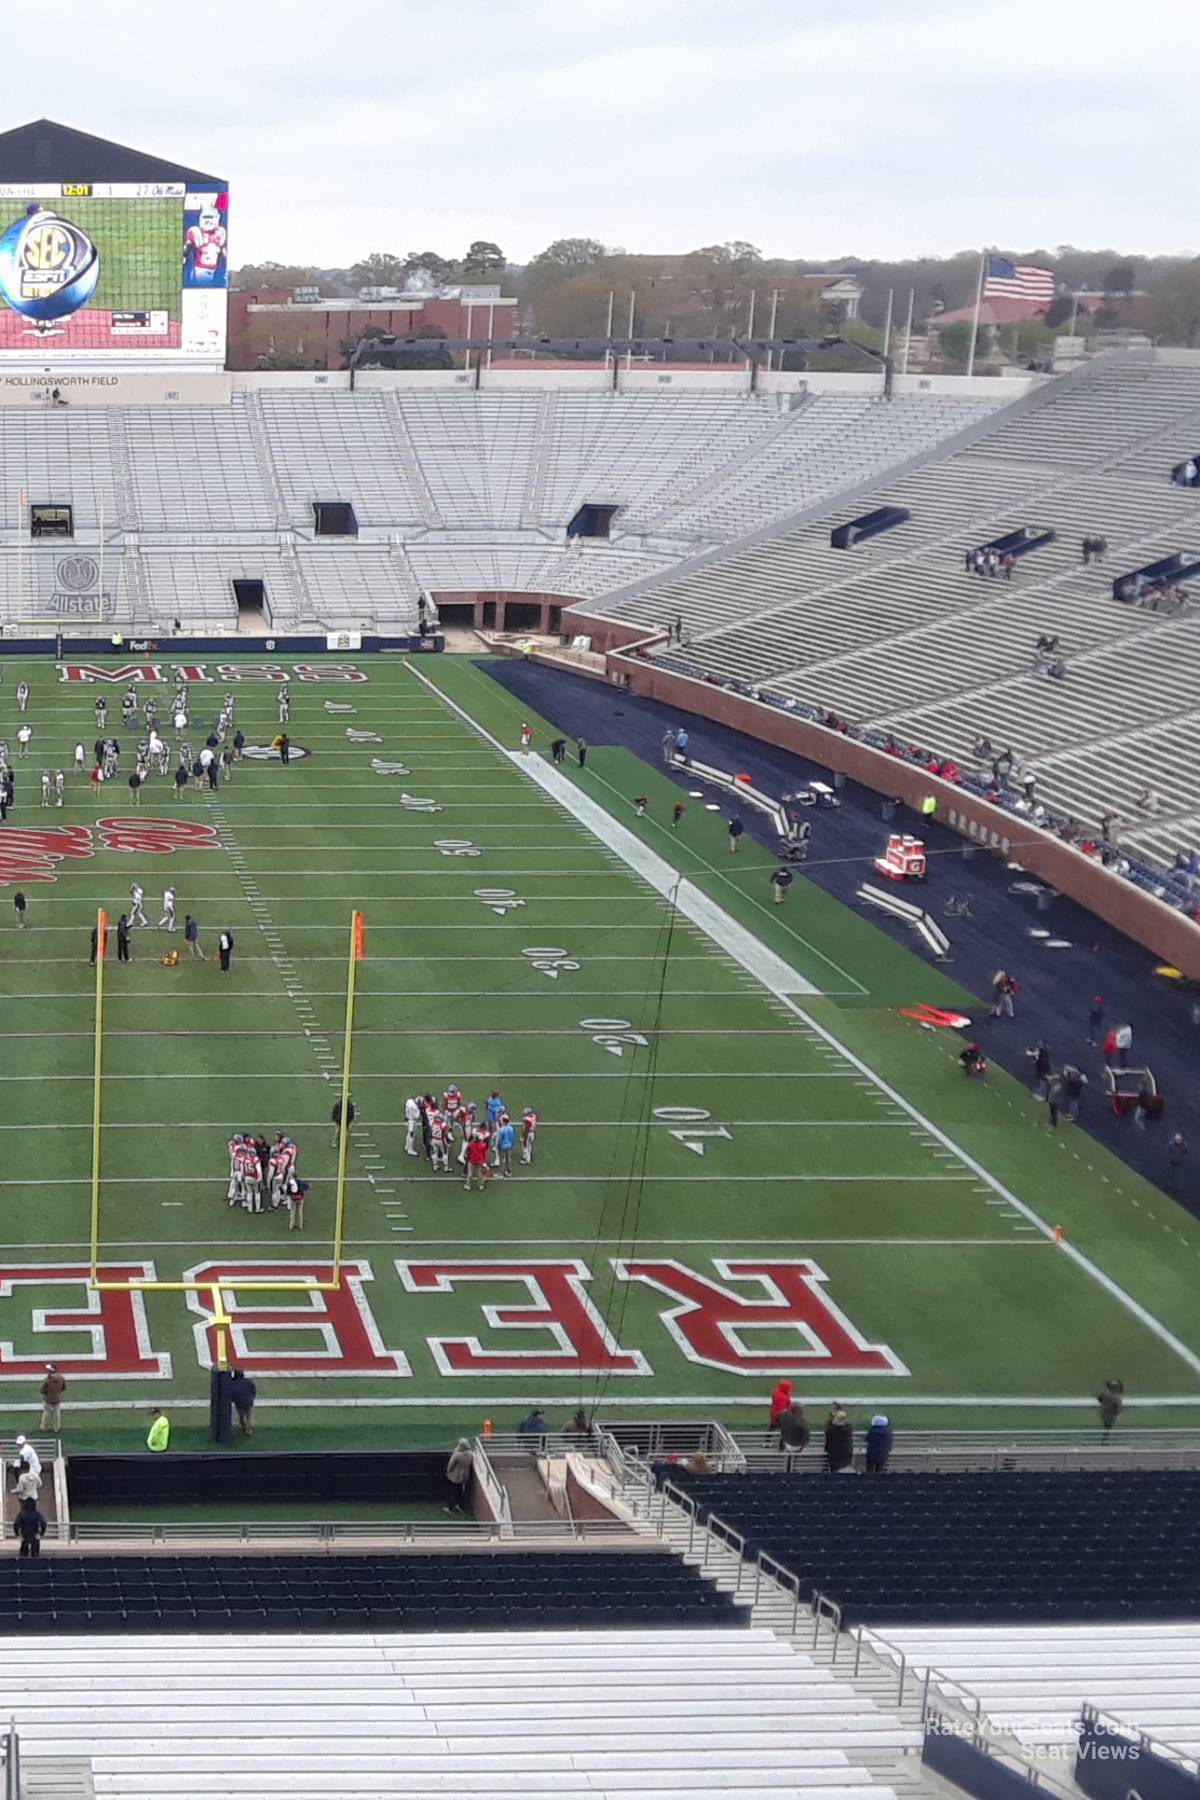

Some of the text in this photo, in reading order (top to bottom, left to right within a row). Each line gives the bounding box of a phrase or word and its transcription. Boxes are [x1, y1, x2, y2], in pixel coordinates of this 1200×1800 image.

[63, 185, 89, 195] 12:01
[25, 227, 69, 270] SEC
[5, 377, 90, 386] HOLLINGSWORTH
[91, 377, 119, 385] FIELD
[48, 594, 110, 612] Allstate
[54, 663, 370, 683] MISS
[521, 947, 581, 971] 30
[579, 1018, 649, 1046] 20
[652, 1106, 734, 1140] 10
